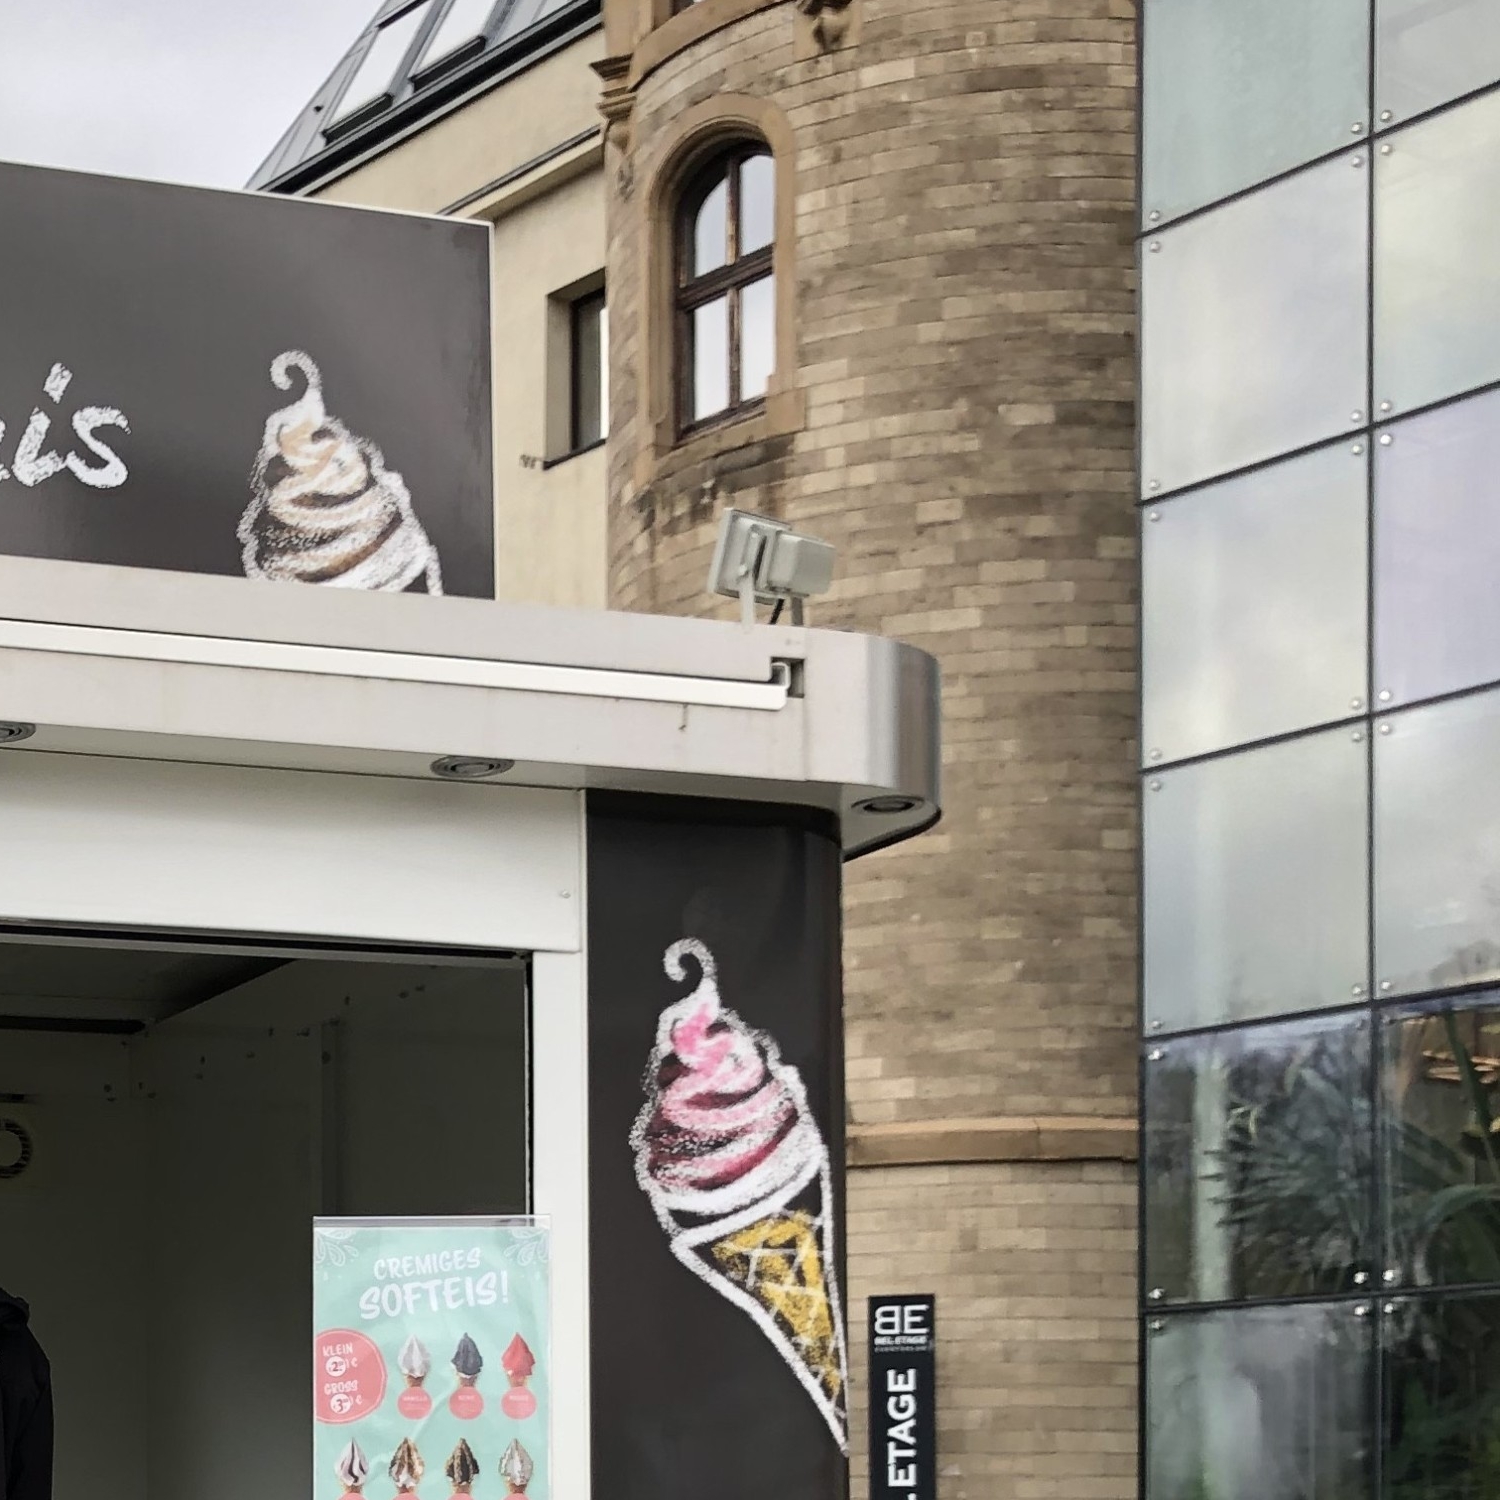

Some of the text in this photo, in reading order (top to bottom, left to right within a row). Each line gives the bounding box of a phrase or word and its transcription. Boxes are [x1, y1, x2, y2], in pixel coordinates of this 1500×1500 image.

[373, 1247, 481, 1281] CREMIGES
[358, 1269, 509, 1320] SOFTEIS!
[887, 1368, 917, 1488] ETAGE
